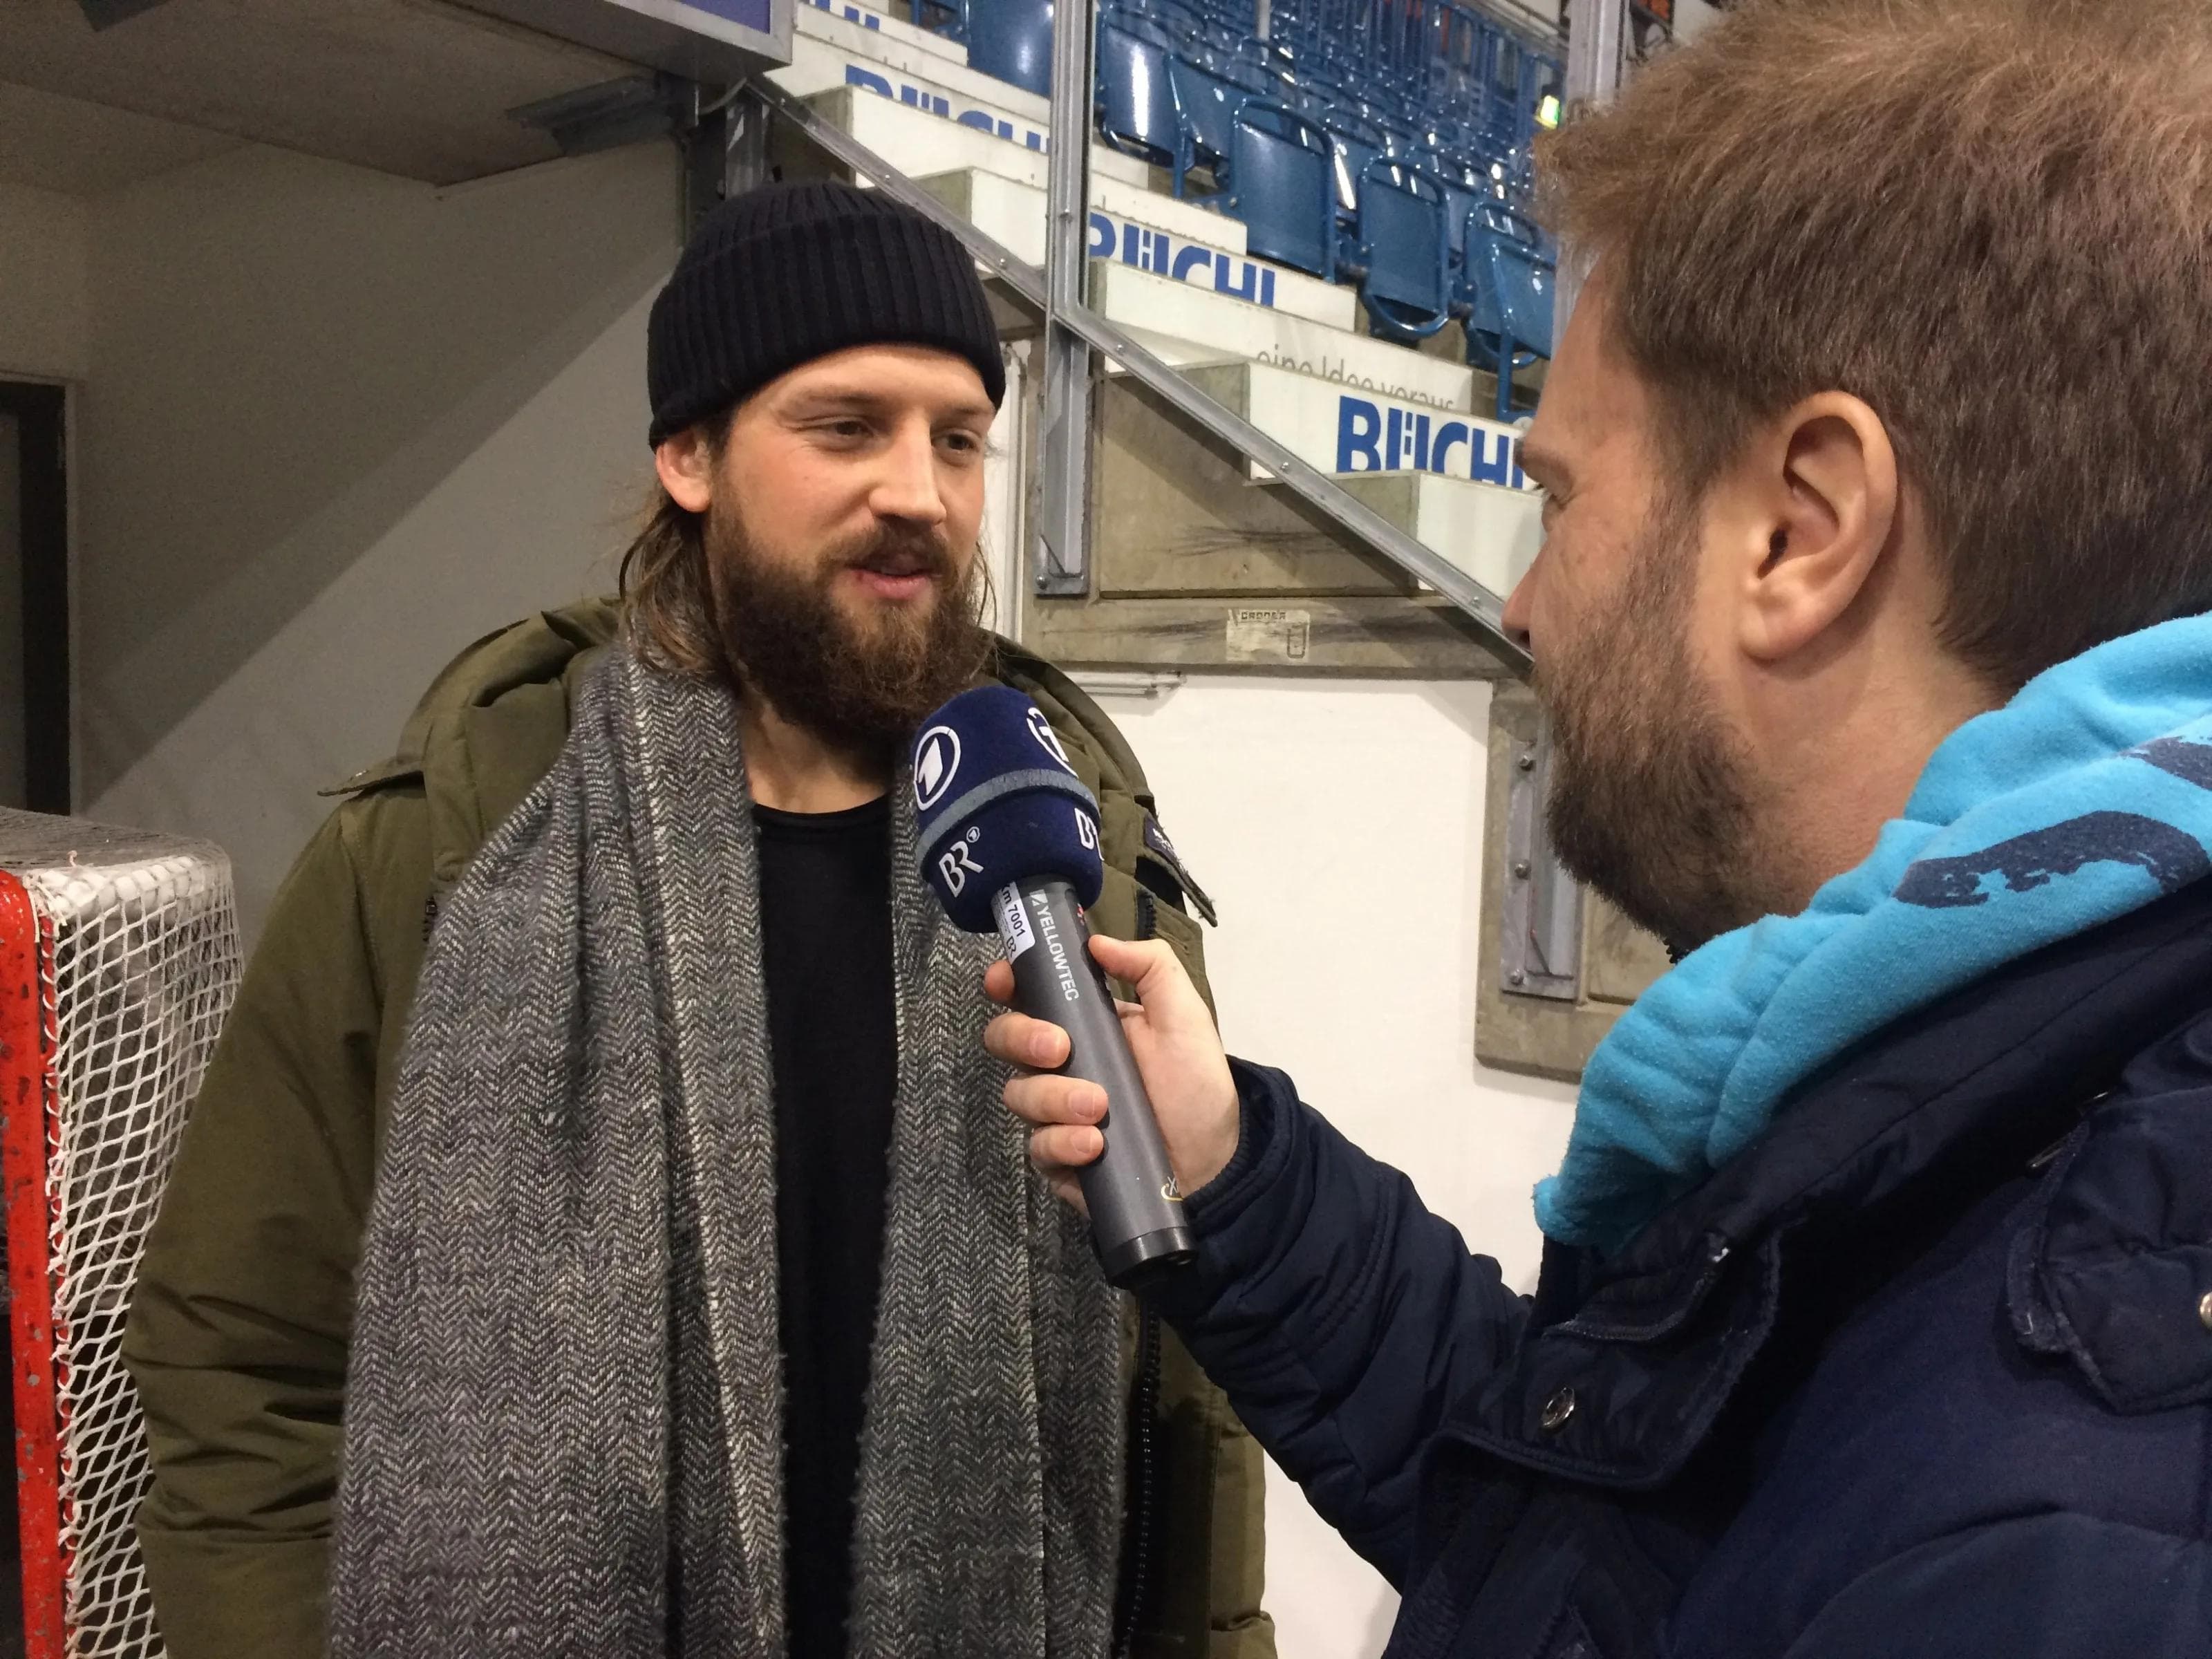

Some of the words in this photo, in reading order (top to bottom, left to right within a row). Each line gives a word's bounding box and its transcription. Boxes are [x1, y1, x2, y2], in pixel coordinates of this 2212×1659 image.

[939, 841, 984, 898] BR
[1009, 904, 1026, 937] 7001
[1038, 906, 1080, 1001] YELLOWTEC
